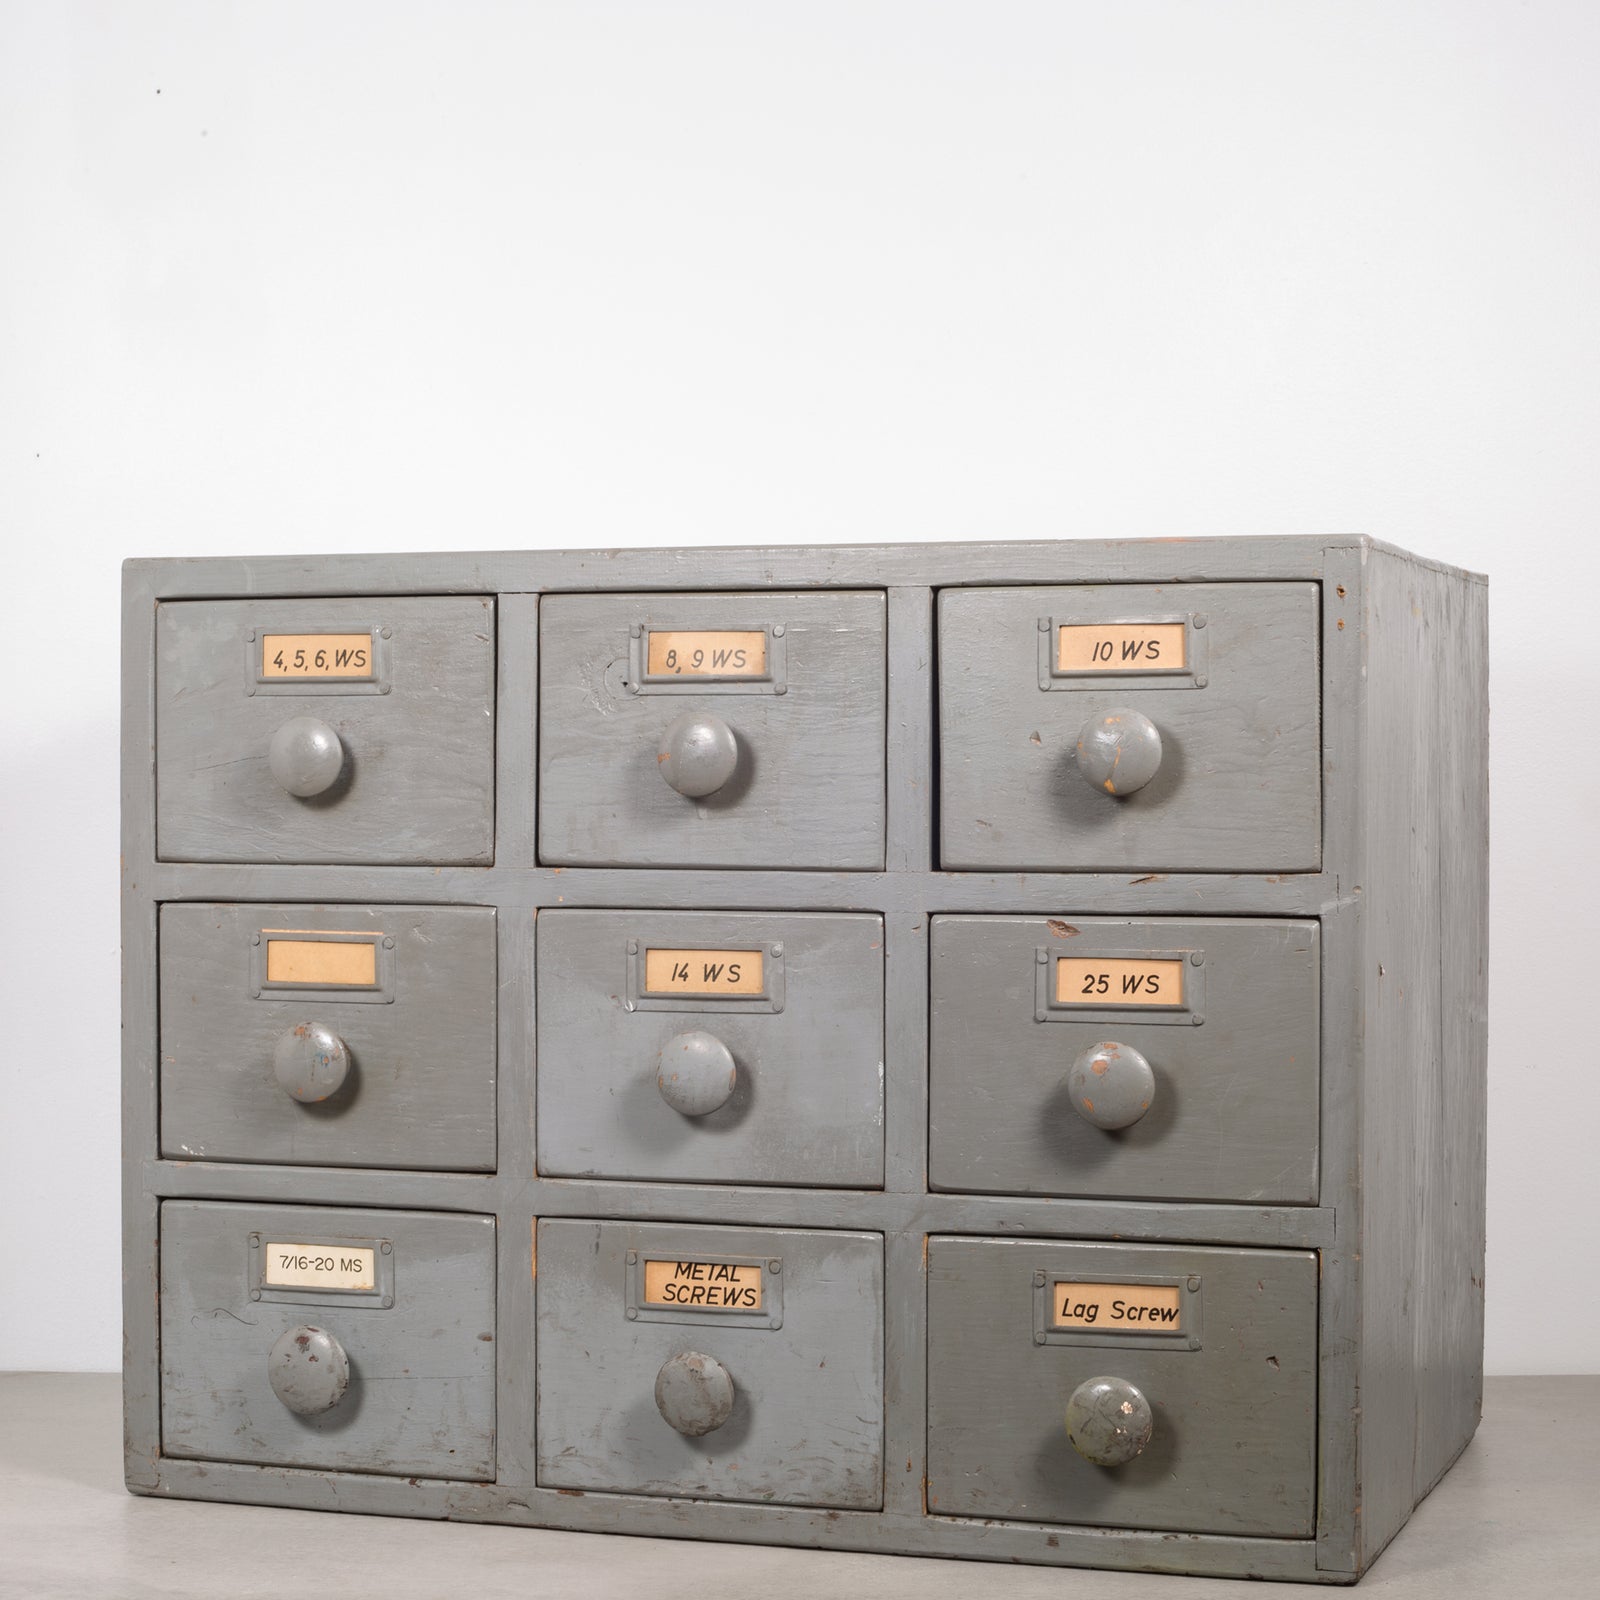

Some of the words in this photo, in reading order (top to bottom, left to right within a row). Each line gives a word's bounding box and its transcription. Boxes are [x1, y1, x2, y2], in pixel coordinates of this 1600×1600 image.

[712, 649, 746, 669] WS
[1092, 641, 1113, 662] 10
[1122, 640, 1160, 661] WS
[671, 962, 689, 982] 14
[703, 963, 741, 983] WS
[1081, 974, 1110, 994] 25
[1122, 974, 1160, 995] WS
[279, 1255, 335, 1271] 7/16-20
[340, 1258, 363, 1273] MS
[674, 1261, 741, 1282] METAL
[662, 1283, 757, 1305] SCREWS
[1061, 1297, 1099, 1323] Lag
[1110, 1300, 1179, 1322] Screw
